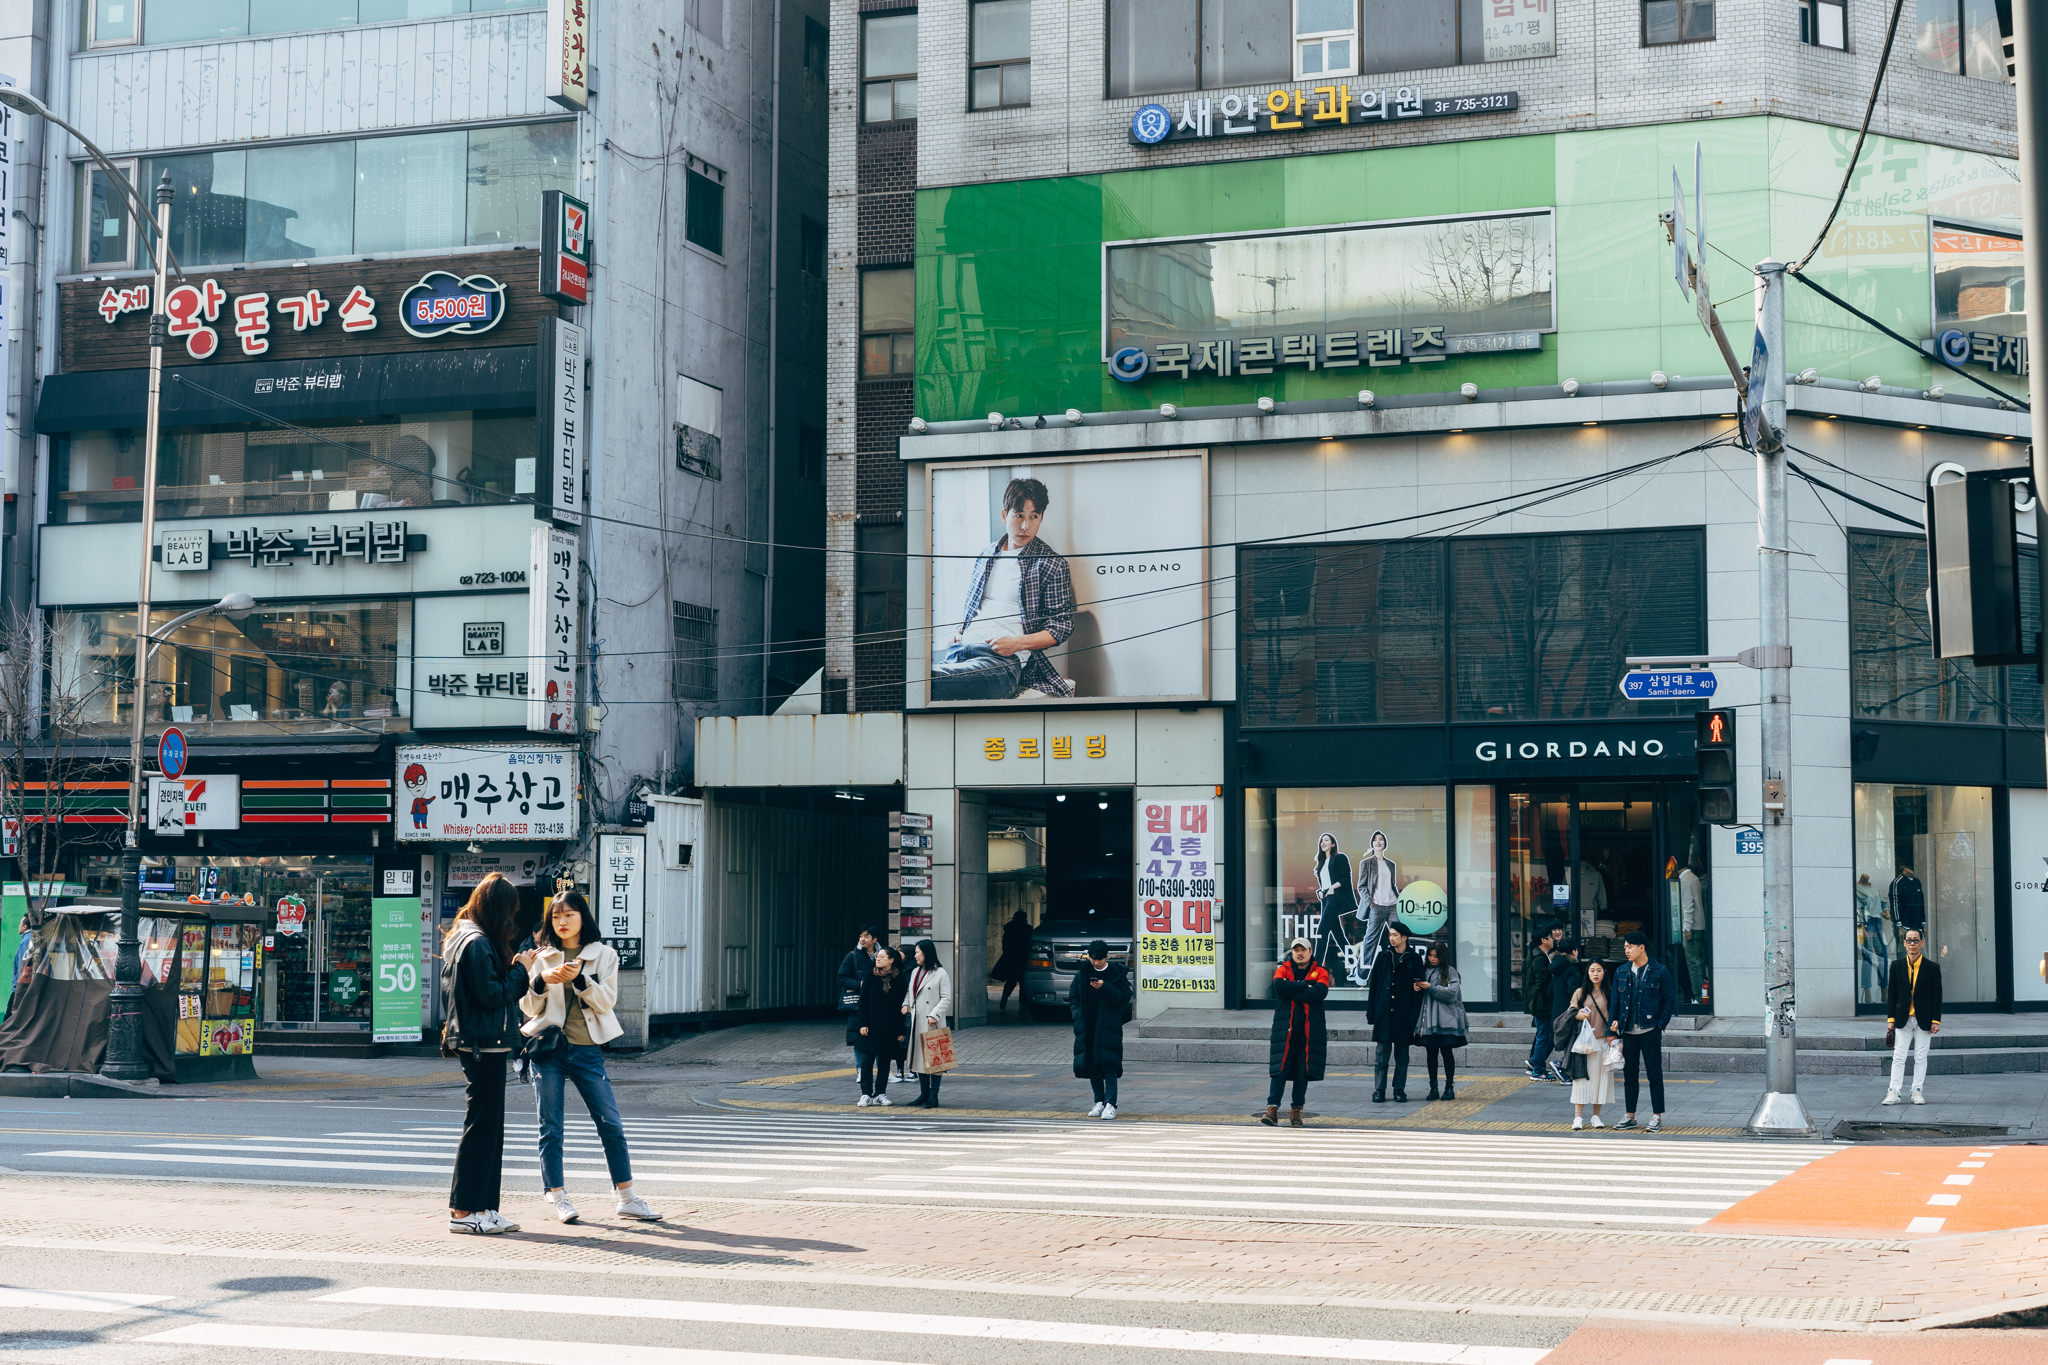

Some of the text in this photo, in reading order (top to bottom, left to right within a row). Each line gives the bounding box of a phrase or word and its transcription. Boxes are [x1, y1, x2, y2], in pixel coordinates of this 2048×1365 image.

[1489, 42, 1551, 58] 010-3704-5798
[1434, 101, 1450, 113] 3F
[1455, 95, 1509, 111] 735-3121
[416, 294, 487, 323] 5,500원
[99, 279, 378, 359] 수제 왕돈가스
[564, 341, 577, 352] LAB
[1155, 325, 1533, 379] 국제콘택트렌즈 735-3121 3F
[275, 374, 342, 391] 박준 뷰티랩
[563, 357, 577, 414] 박준
[562, 418, 576, 504] 뷰티랩
[167, 542, 202, 550] BEAUTY
[226, 520, 408, 568] 박준 뷰티랩
[167, 551, 203, 564] LAB
[1096, 563, 1181, 575] GIORDANO
[475, 571, 526, 584] 723-1004
[553, 551, 573, 672] 맥주창고
[467, 640, 500, 651] LAB
[428, 674, 468, 697] 박준
[1628, 682, 1643, 690] 397
[1649, 675, 1695, 687] 삼일대로
[1700, 681, 1715, 689] 401
[1648, 688, 1696, 696] Samil-daero
[983, 734, 1107, 761] 종로빌딩
[1475, 739, 1664, 761] GIORDANO
[508, 753, 563, 765] 음악신청가능
[160, 789, 184, 803] 견인지역
[440, 771, 565, 819] 맥주창고
[1145, 805, 1208, 834] 임대
[534, 823, 564, 835] 733-4136
[1150, 836, 1202, 857] 4층
[1741, 842, 1763, 853] 395
[609, 856, 635, 871] 박준
[386, 871, 412, 884] 임대
[1138, 878, 1215, 898] 010-6390-3999
[611, 873, 630, 935] 뷰티랩
[421, 912, 432, 922] 4+1
[1143, 899, 1212, 934] 임대
[1281, 914, 1323, 939] THE
[1142, 937, 1158, 951] 5층
[378, 962, 416, 993] 50
[1142, 978, 1216, 991] 010-2261-0133
